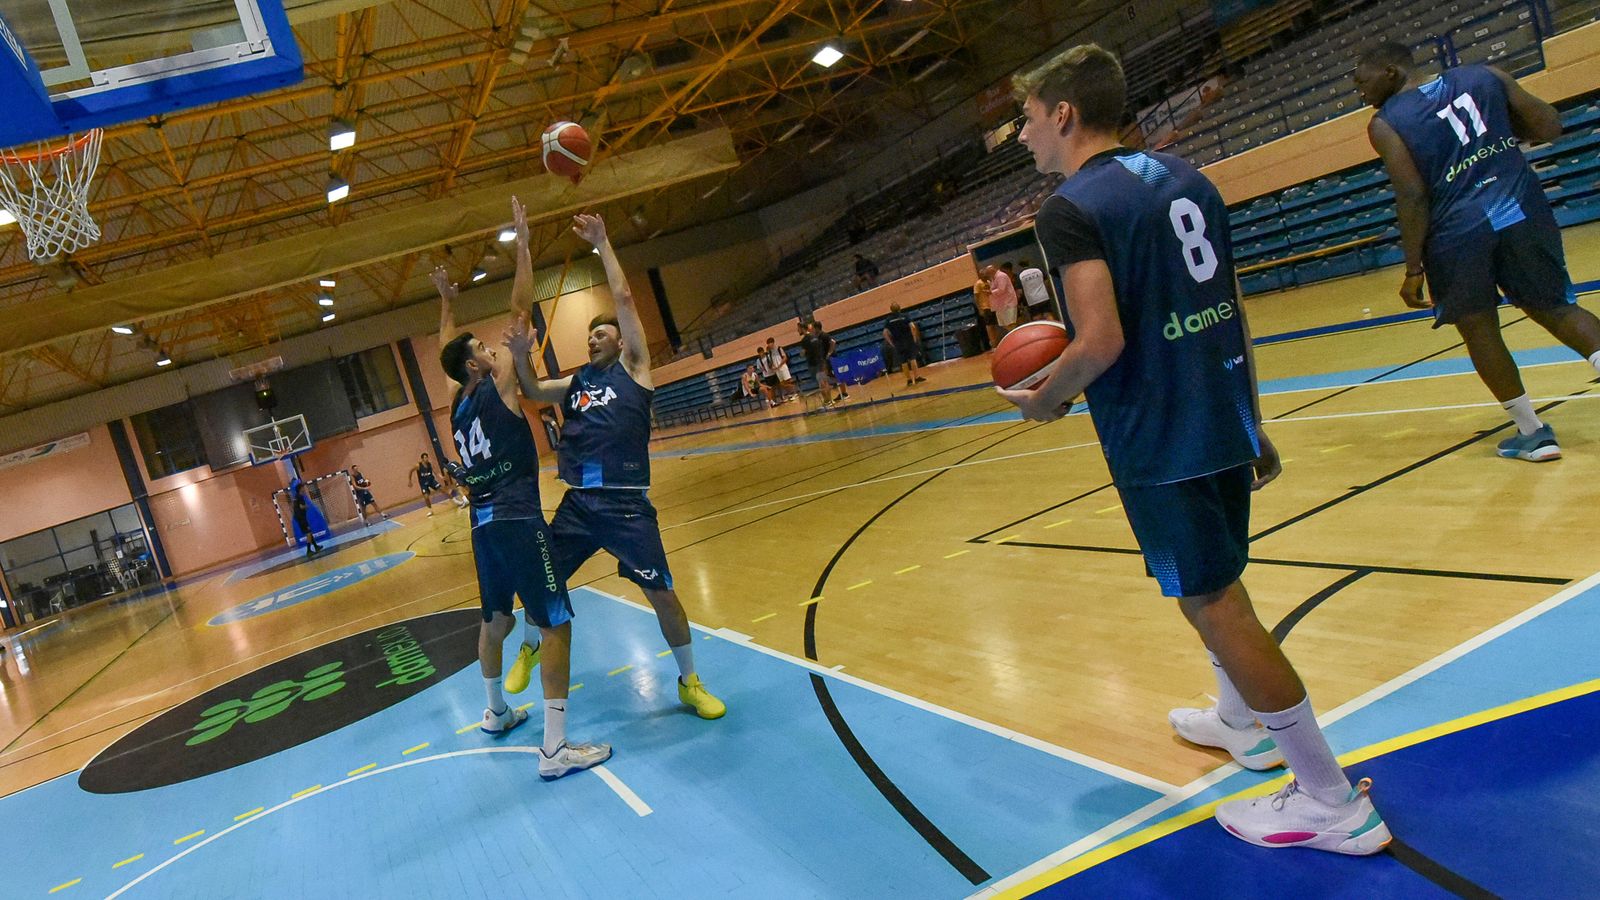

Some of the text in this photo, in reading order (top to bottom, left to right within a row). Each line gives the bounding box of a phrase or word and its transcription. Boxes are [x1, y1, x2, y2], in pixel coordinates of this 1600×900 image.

[1436, 92, 1488, 146] 11
[1169, 197, 1219, 283] 8
[1163, 299, 1237, 341] dame
[454, 416, 493, 469] 14
[536, 530, 558, 593] damex.io
